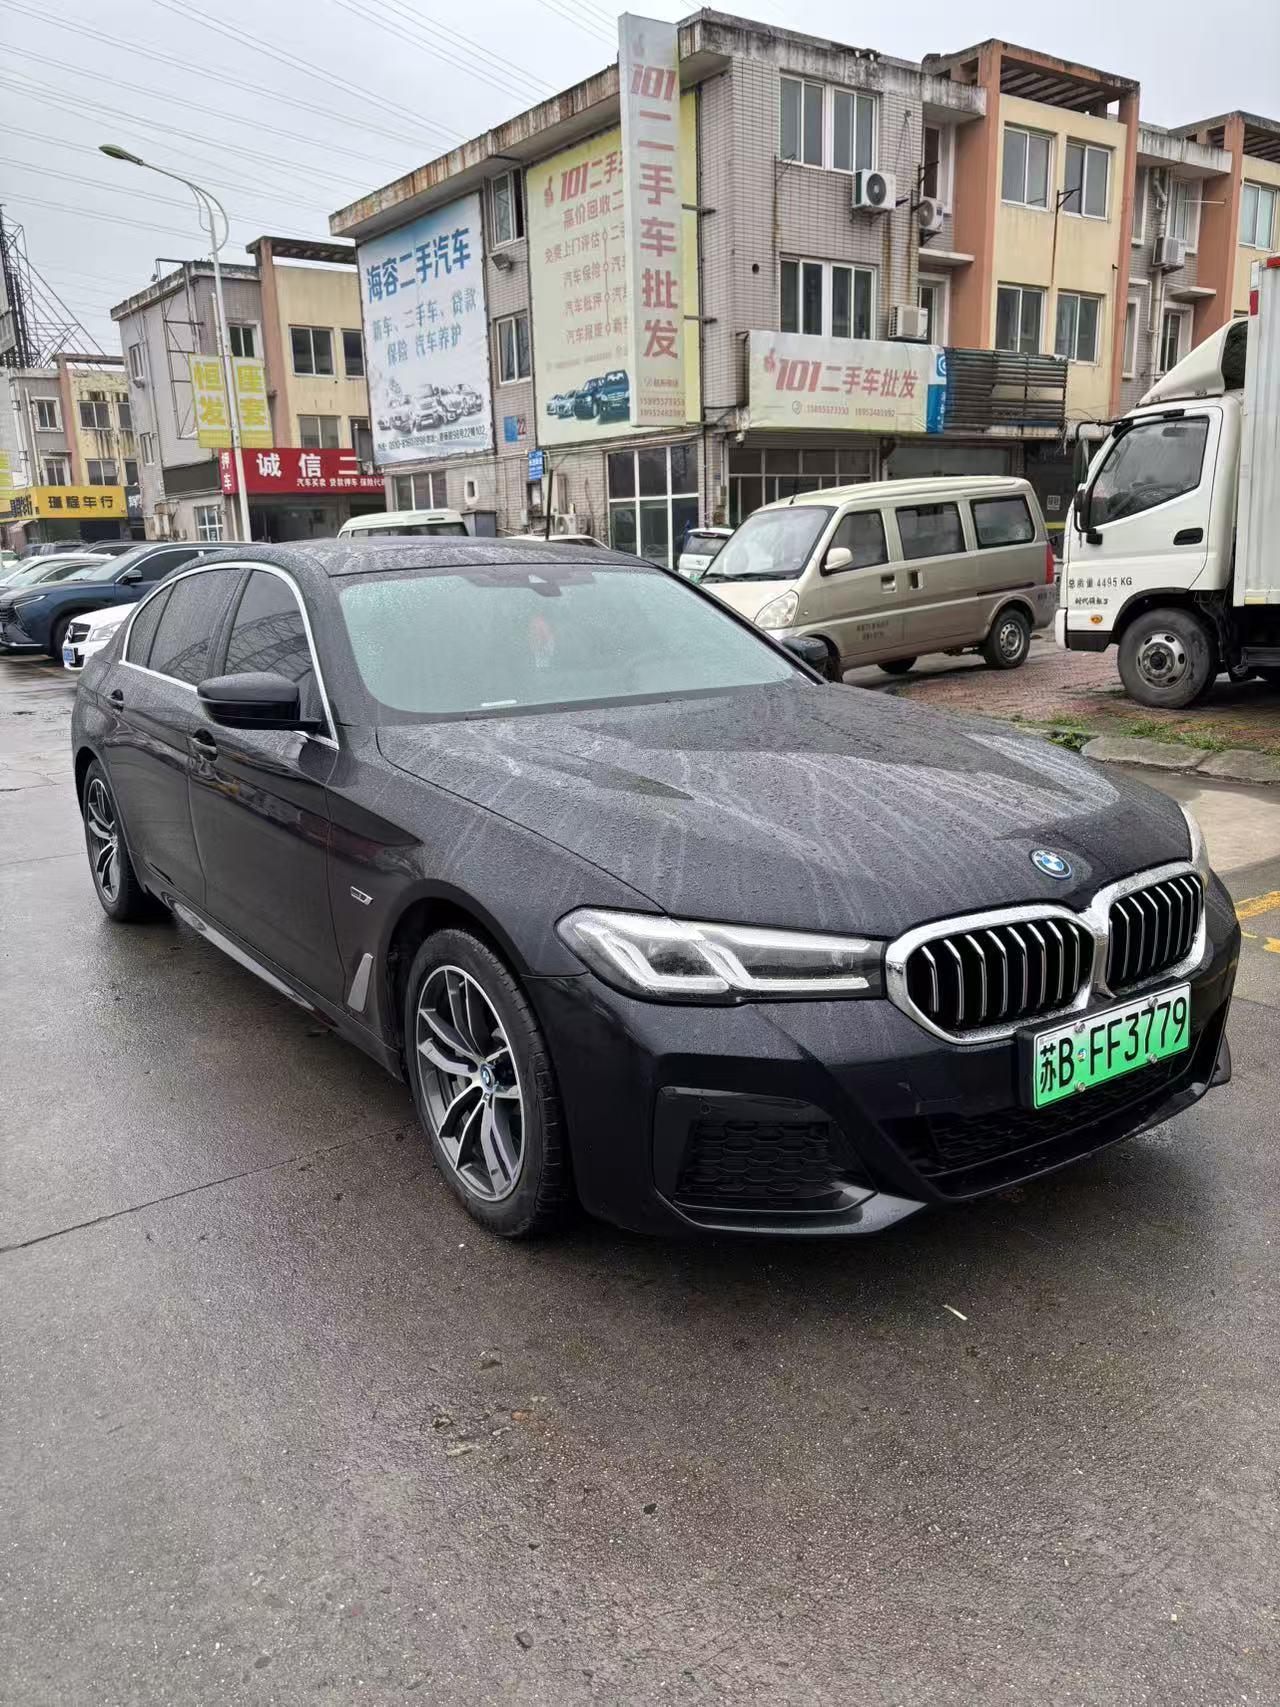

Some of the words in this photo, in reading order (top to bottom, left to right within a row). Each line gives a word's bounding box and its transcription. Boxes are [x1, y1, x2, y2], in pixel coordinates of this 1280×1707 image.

[560, 151, 623, 202] 101二手
[366, 228, 471, 303] 海容二手汽车
[775, 357, 918, 399] 101二手车批发
